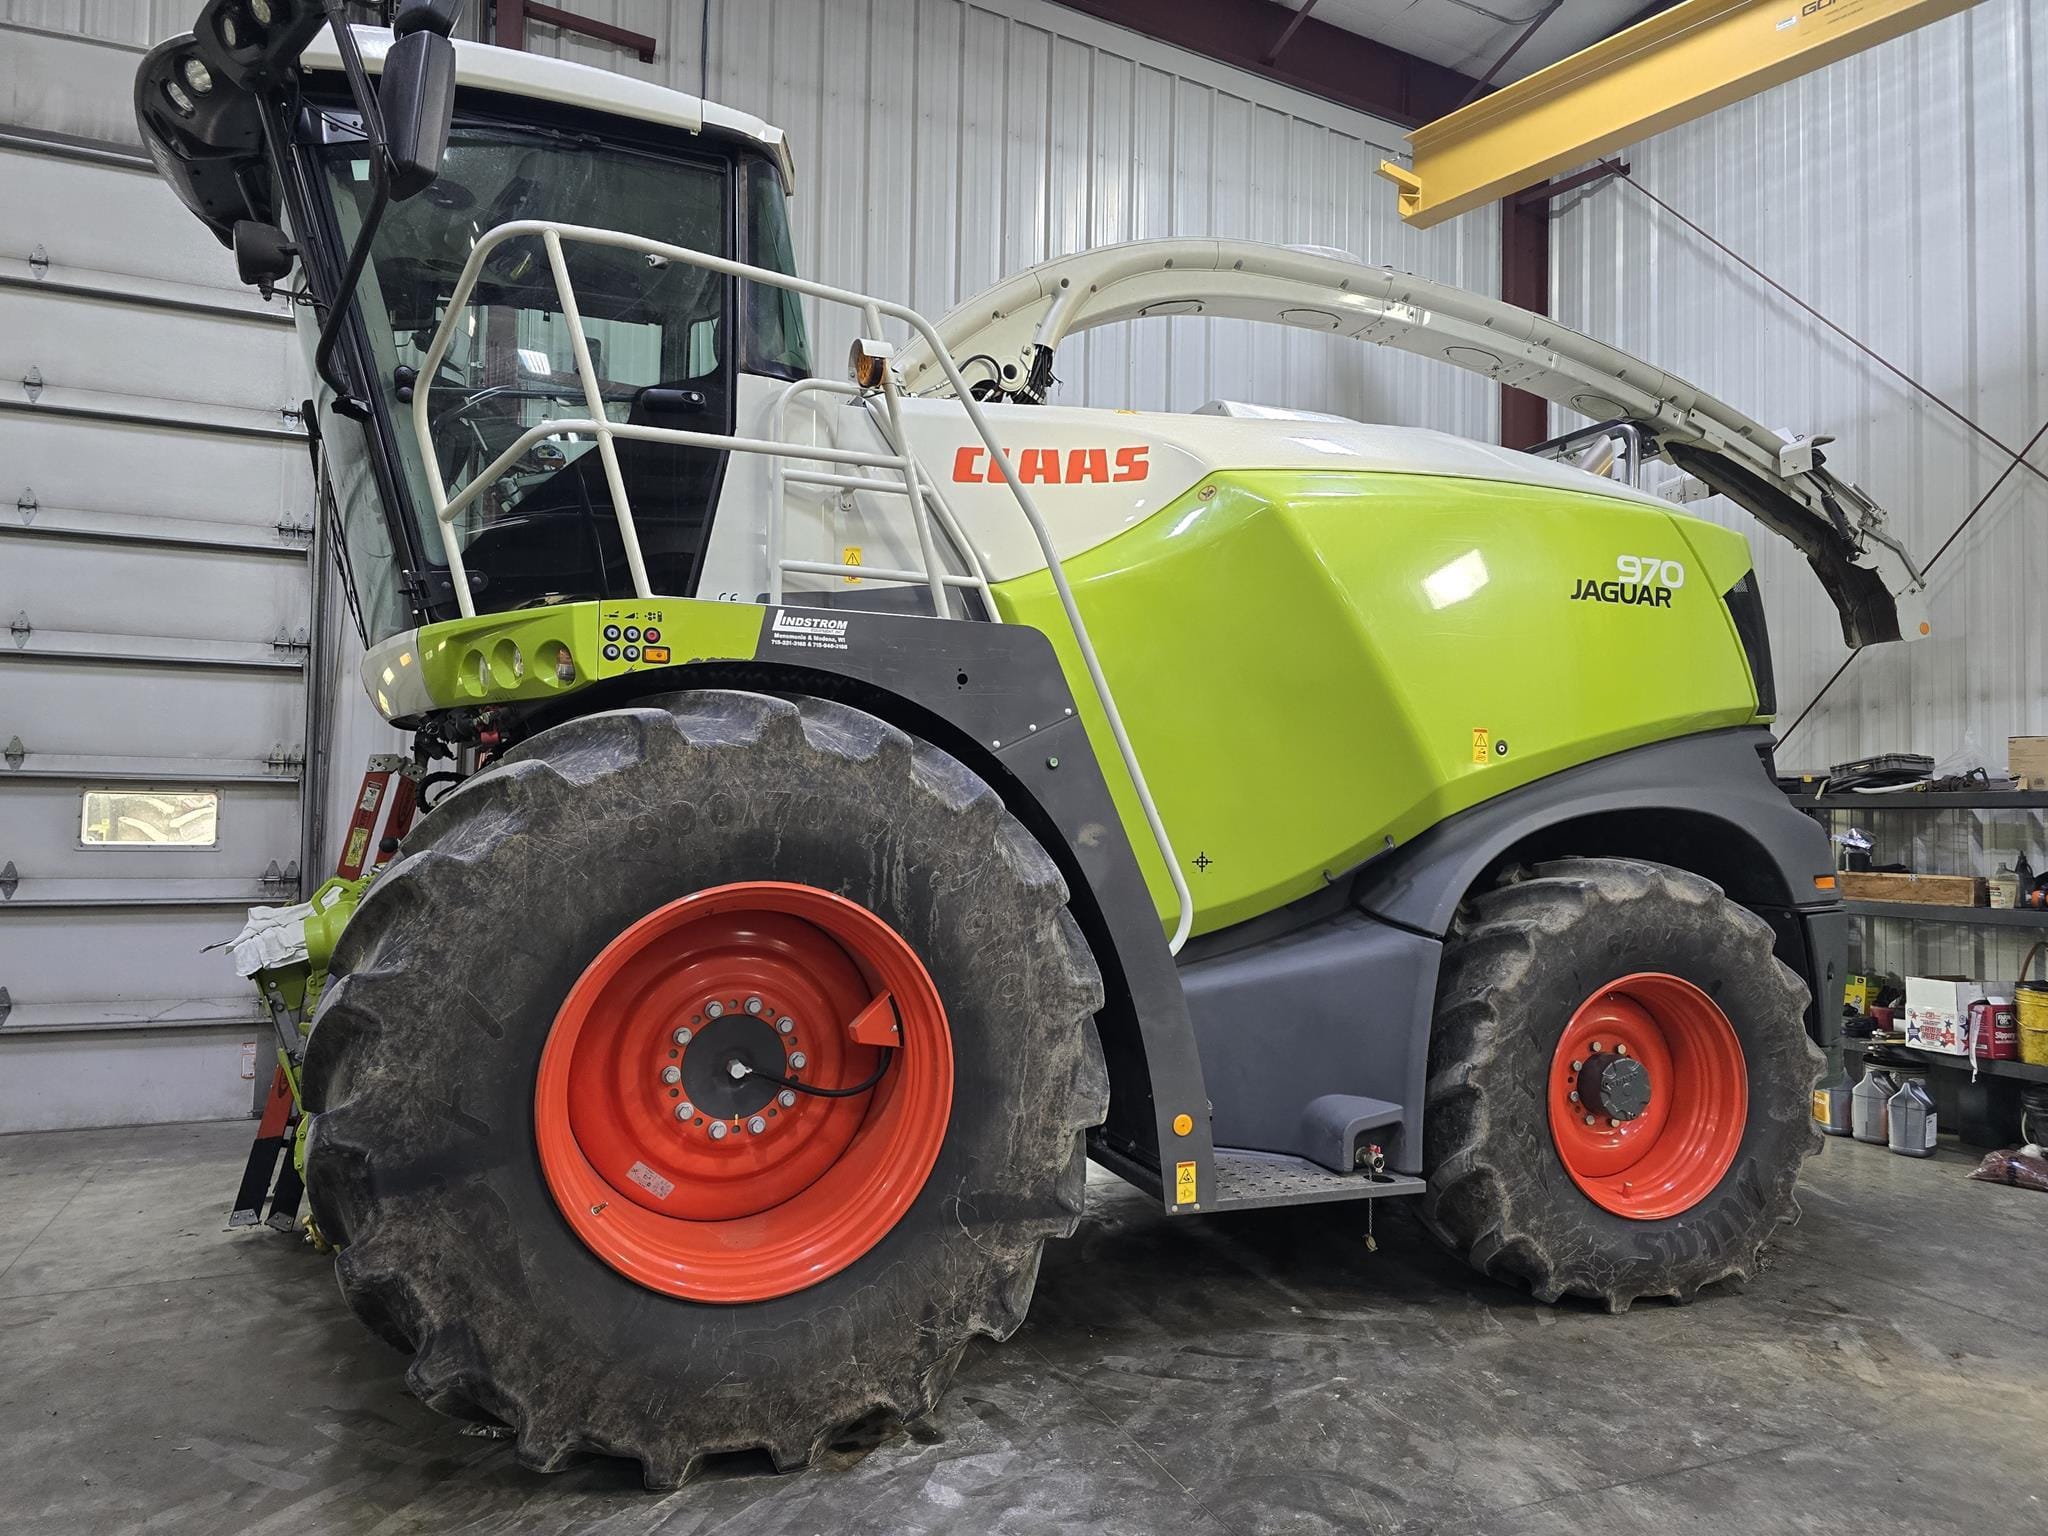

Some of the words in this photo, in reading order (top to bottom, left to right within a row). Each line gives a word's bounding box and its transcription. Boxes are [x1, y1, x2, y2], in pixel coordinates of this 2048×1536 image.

[953, 446, 1150, 484] CLAAS
[1617, 554, 1685, 588] 970
[1570, 578, 1672, 609] JAGUAR
[772, 609, 848, 632] LINDSTROM
